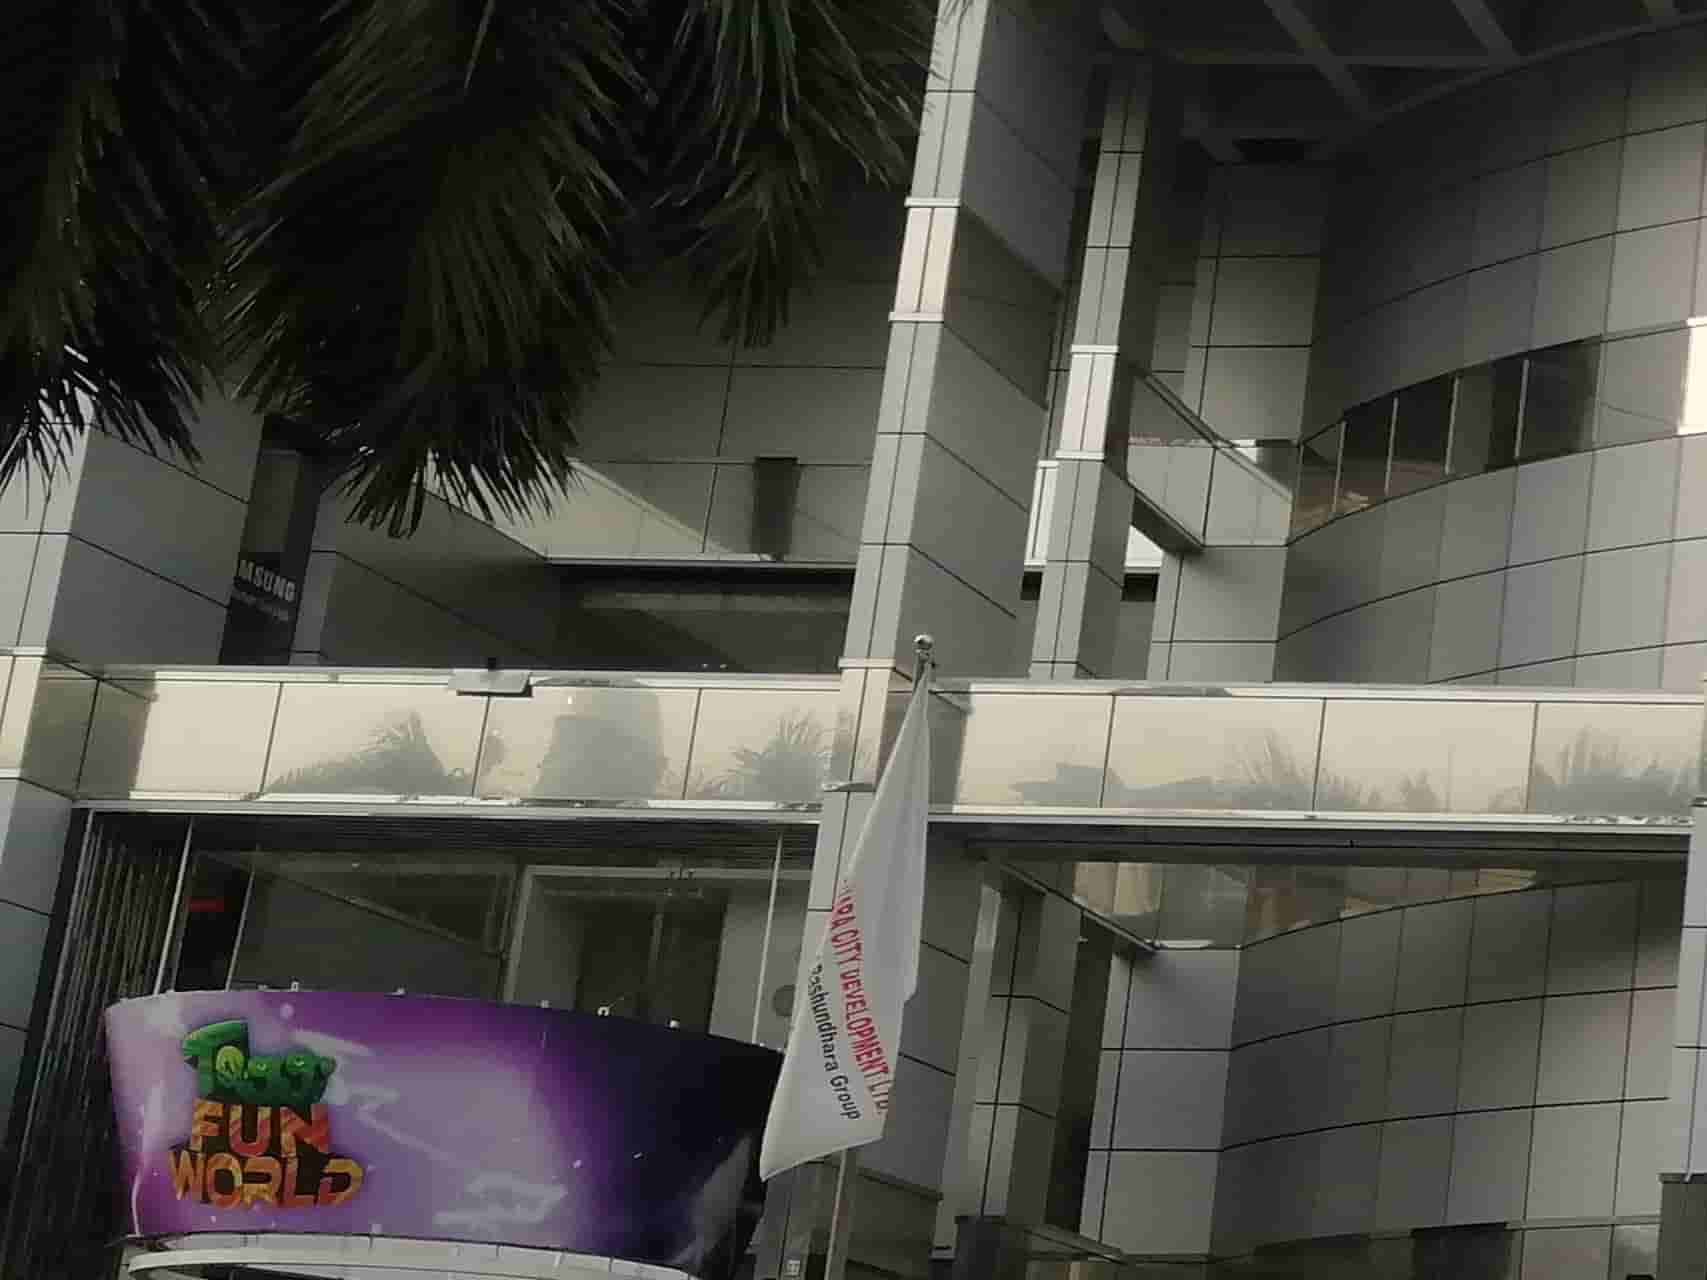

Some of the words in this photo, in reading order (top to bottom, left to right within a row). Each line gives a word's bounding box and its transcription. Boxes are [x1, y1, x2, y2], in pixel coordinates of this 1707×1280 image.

[829, 1074, 860, 1121] Group
[190, 1097, 331, 1157] FUN
[169, 1149, 363, 1207] WORLD
